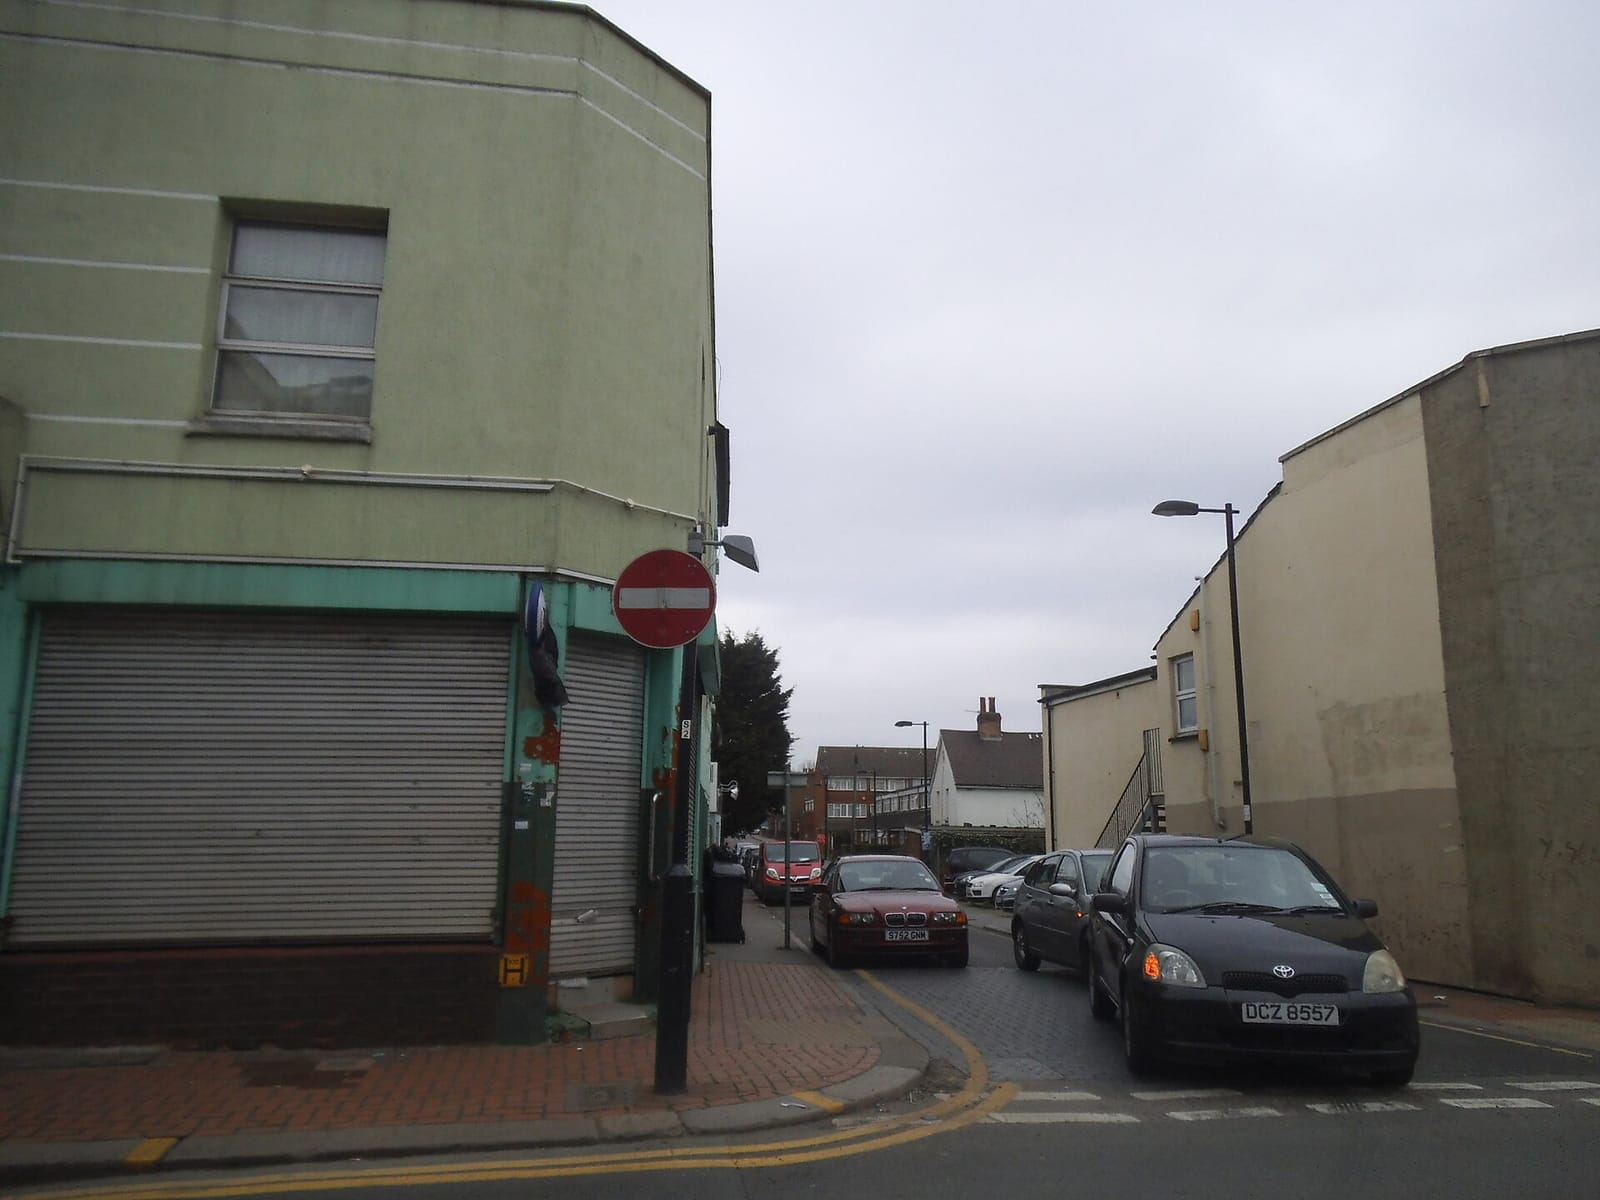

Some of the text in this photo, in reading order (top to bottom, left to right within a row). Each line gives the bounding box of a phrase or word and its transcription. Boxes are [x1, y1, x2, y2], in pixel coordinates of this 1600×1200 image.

[503, 957, 524, 984] H
[1246, 1003, 1335, 1022] DCZ 8557
